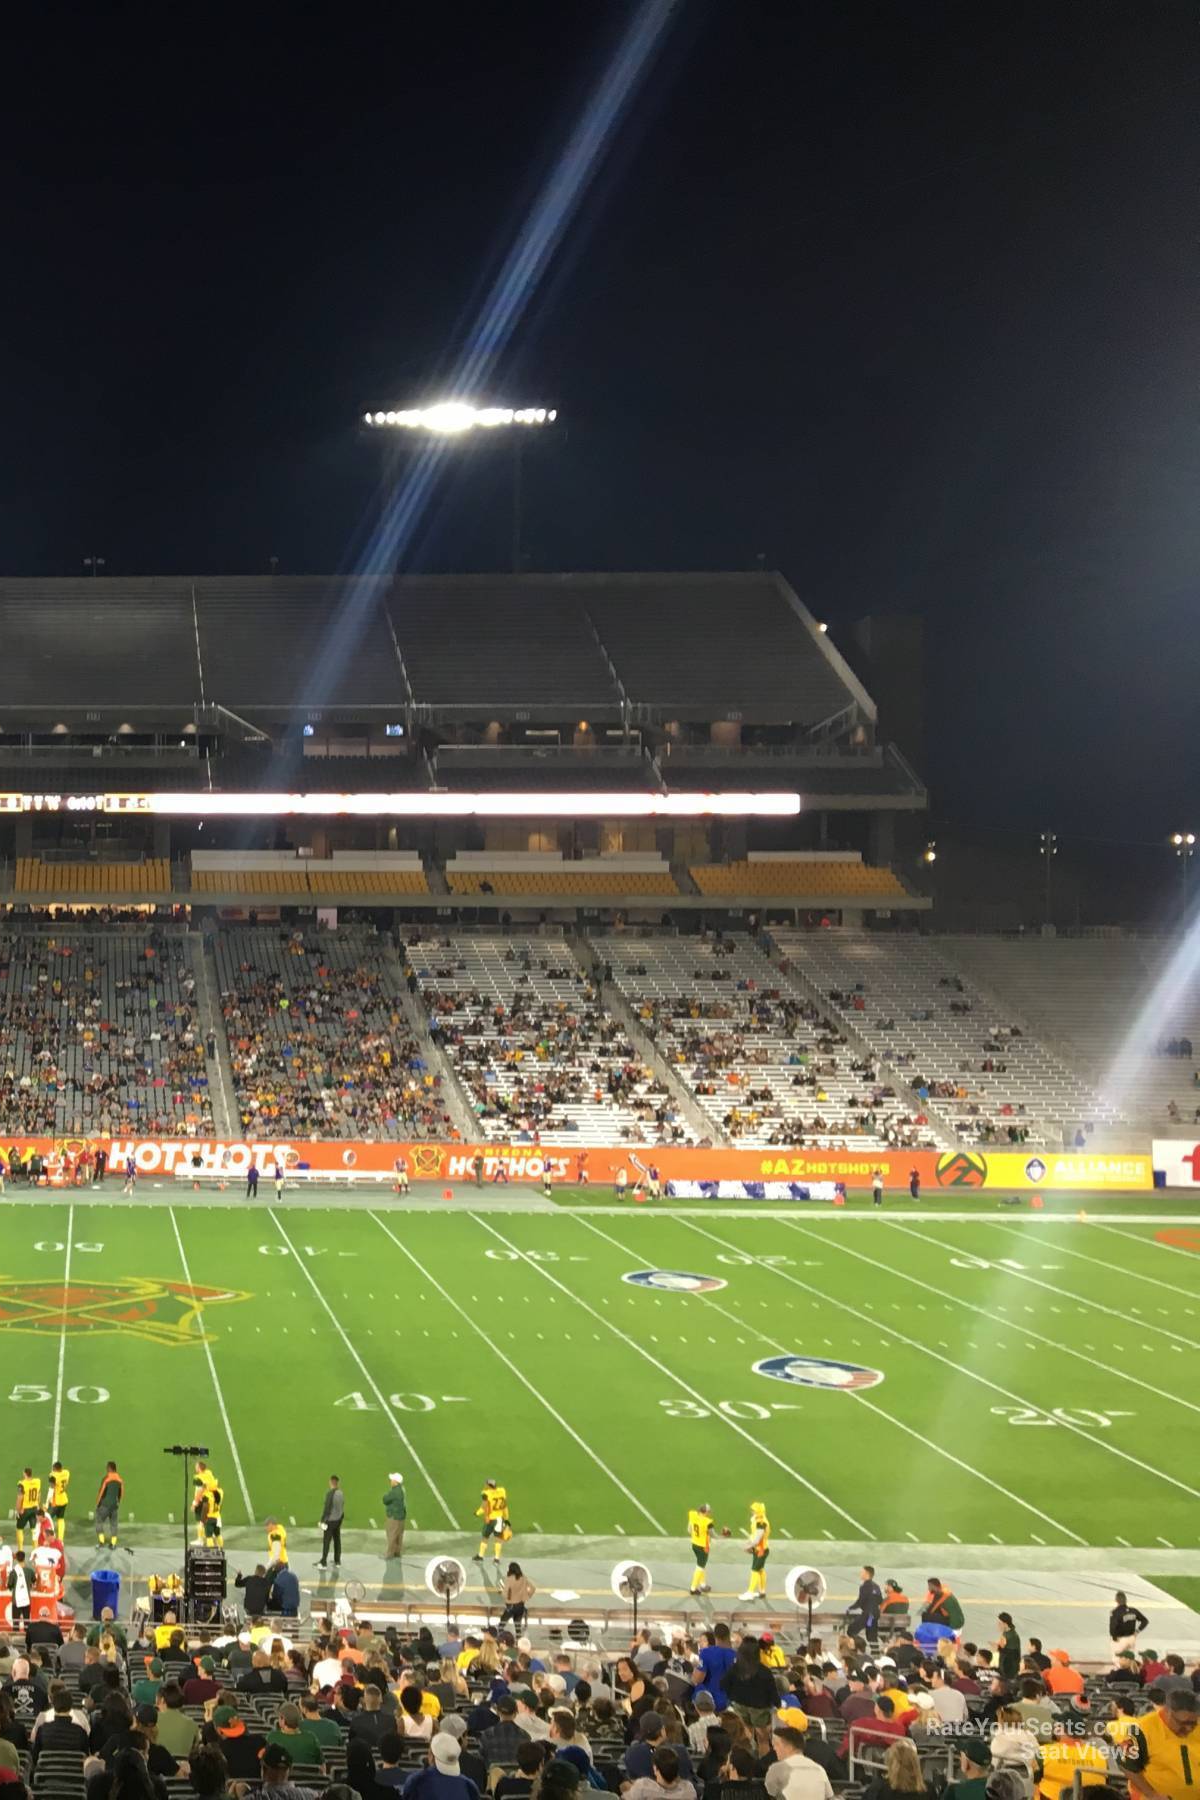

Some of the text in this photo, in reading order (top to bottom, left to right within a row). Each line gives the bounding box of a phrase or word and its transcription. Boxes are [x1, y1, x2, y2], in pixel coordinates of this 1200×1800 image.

[474, 1148, 542, 1157] ARIZONA
[760, 1158, 890, 1176] #AZHOTSHOTS
[33, 1241, 105, 1253] 50
[258, 1245, 329, 1257] 40
[484, 1248, 560, 1261] 30
[8, 1384, 111, 1404] 50
[333, 1391, 437, 1412] 40
[658, 1399, 771, 1420] 30
[990, 1406, 1113, 1427] 20
[28, 1488, 38, 1502] 10
